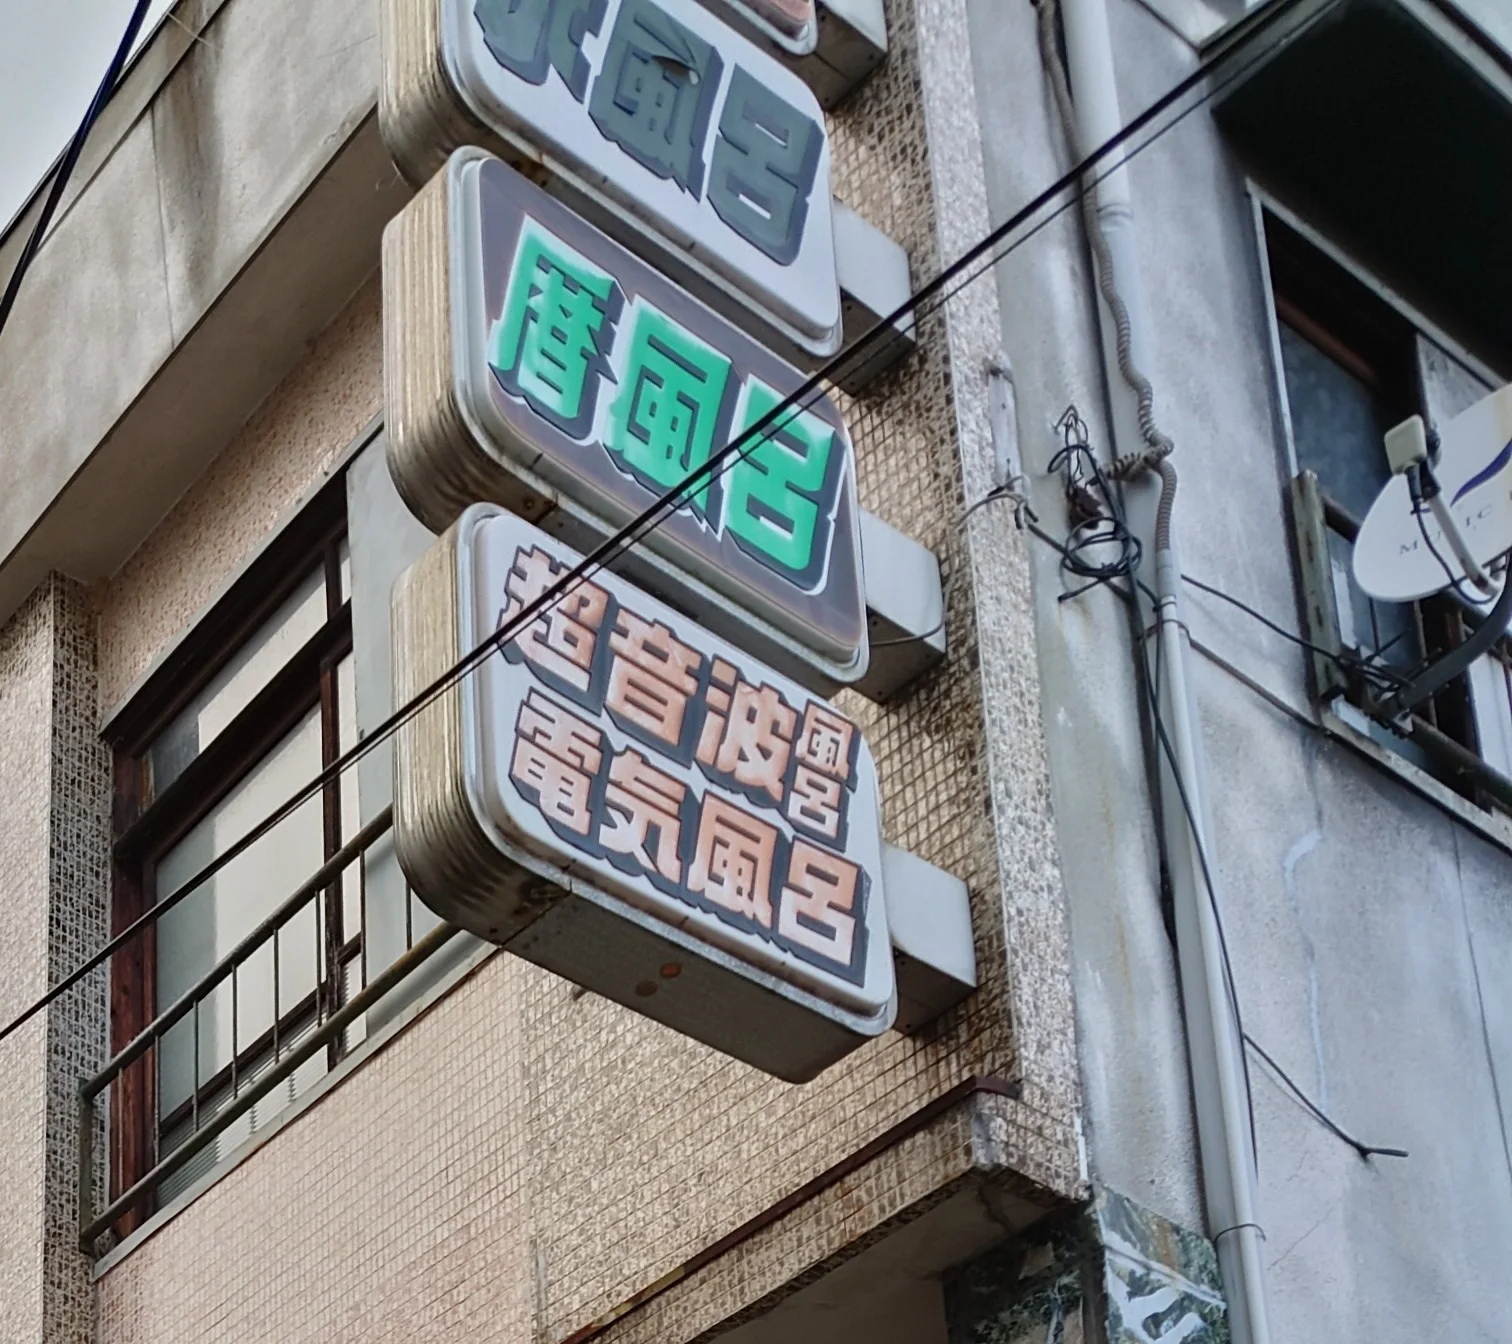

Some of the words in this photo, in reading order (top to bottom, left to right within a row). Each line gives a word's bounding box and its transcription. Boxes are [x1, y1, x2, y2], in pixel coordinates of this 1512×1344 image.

[1398, 503, 1493, 556] MIC
[508, 686, 872, 988] 電気風呂
